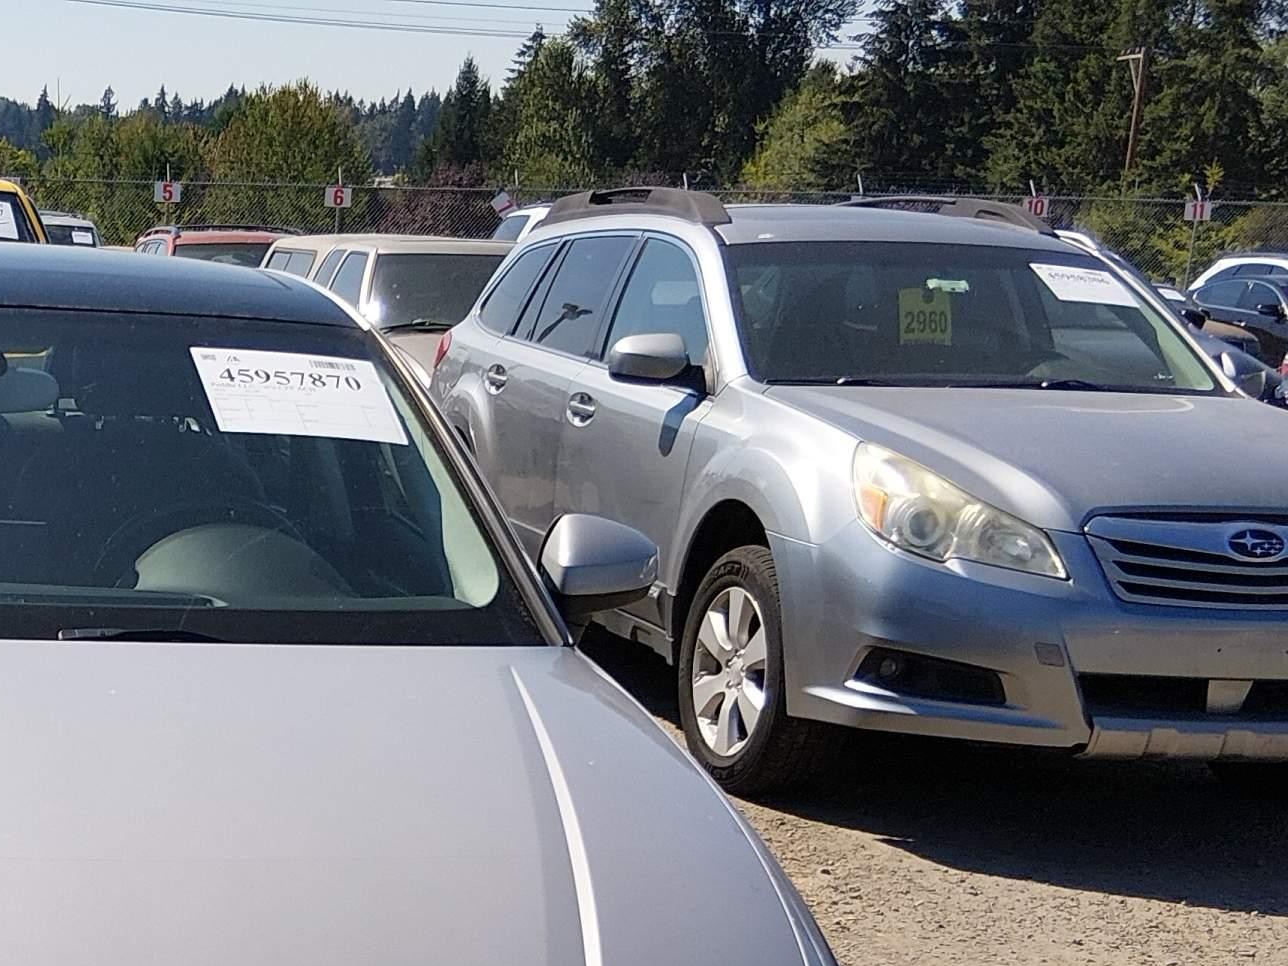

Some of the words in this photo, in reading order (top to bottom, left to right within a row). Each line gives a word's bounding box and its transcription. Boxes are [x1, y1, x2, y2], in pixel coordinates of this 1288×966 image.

[162, 183, 173, 202] 5
[333, 188, 345, 206] 6
[1191, 202, 1206, 220] 11
[903, 309, 948, 335] 2960
[219, 367, 362, 392] 45957870
